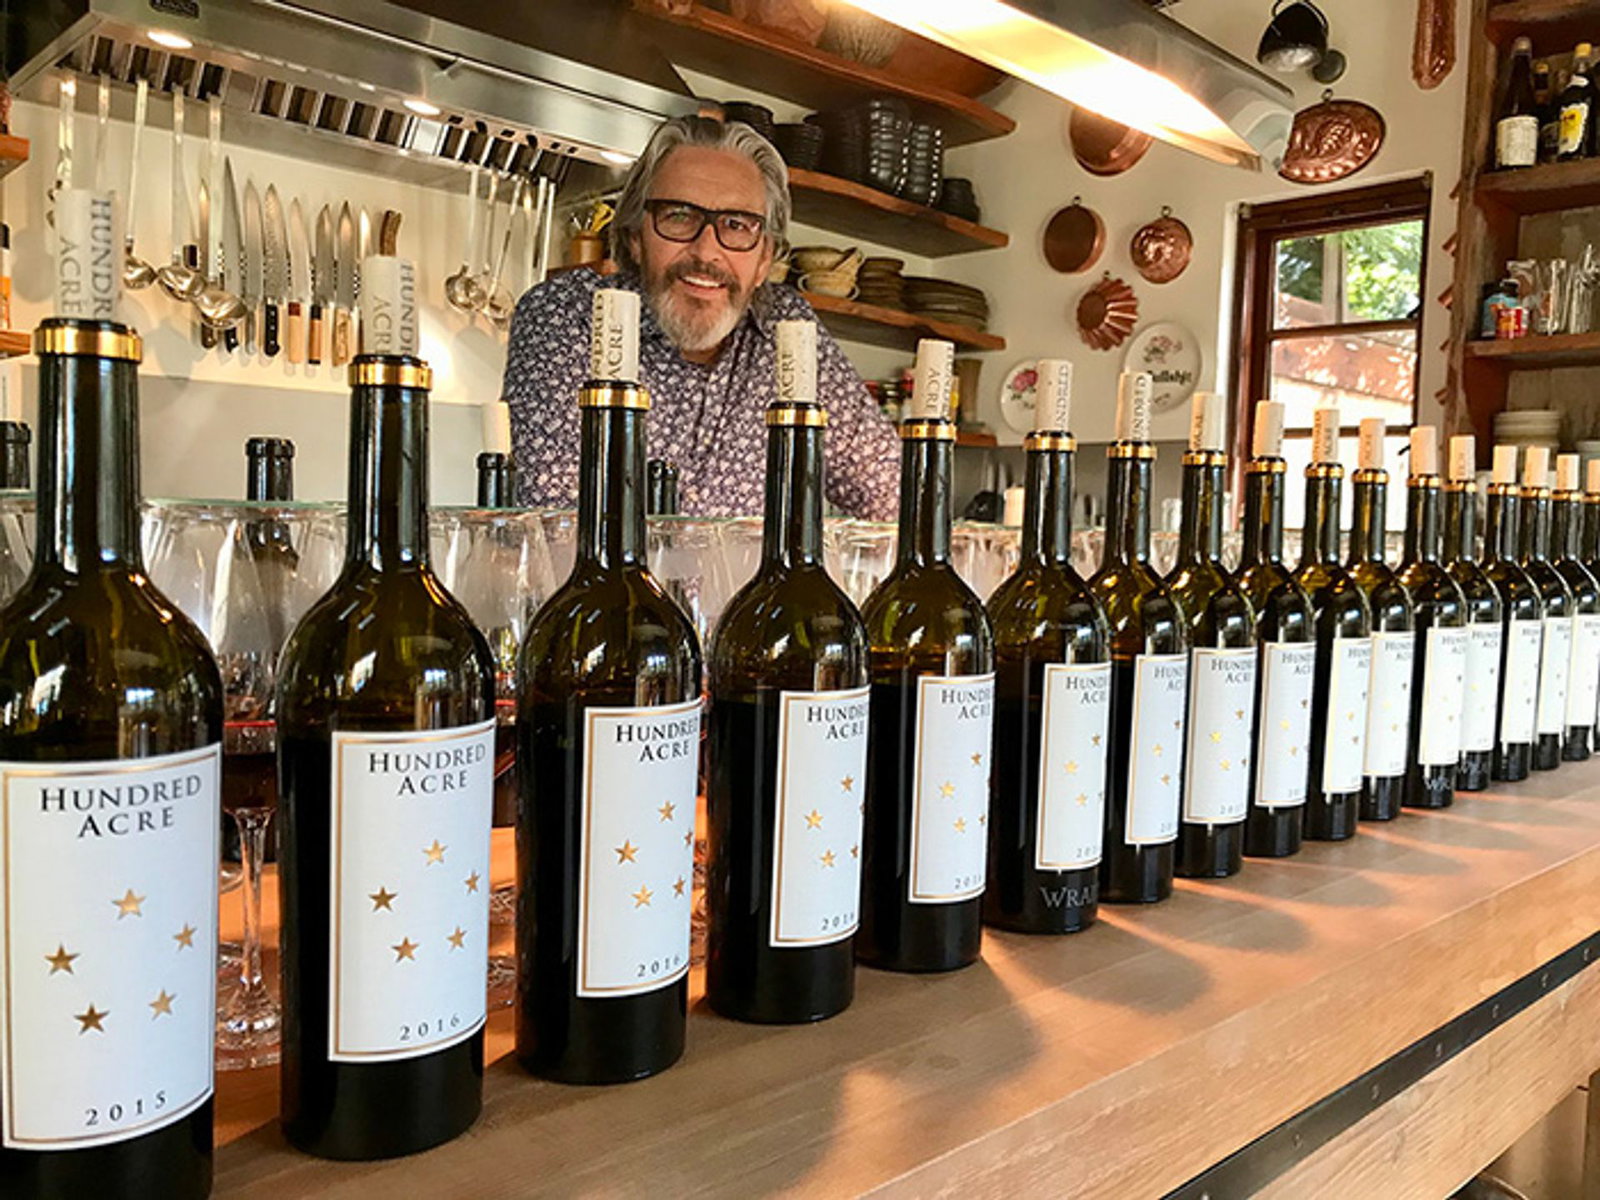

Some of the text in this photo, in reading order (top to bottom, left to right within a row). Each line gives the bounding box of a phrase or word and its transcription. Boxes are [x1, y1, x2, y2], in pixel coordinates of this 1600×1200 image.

[59, 235, 82, 314] ACRE
[608, 324, 623, 379] ACRE
[368, 743, 487, 774] HUNDRED
[639, 740, 690, 763] ACRE
[40, 773, 202, 813] HUNDRED
[397, 770, 469, 796] ACRE
[77, 806, 175, 839] ACRE
[400, 1014, 461, 1041] 2016
[85, 1090, 167, 1127] 2015
